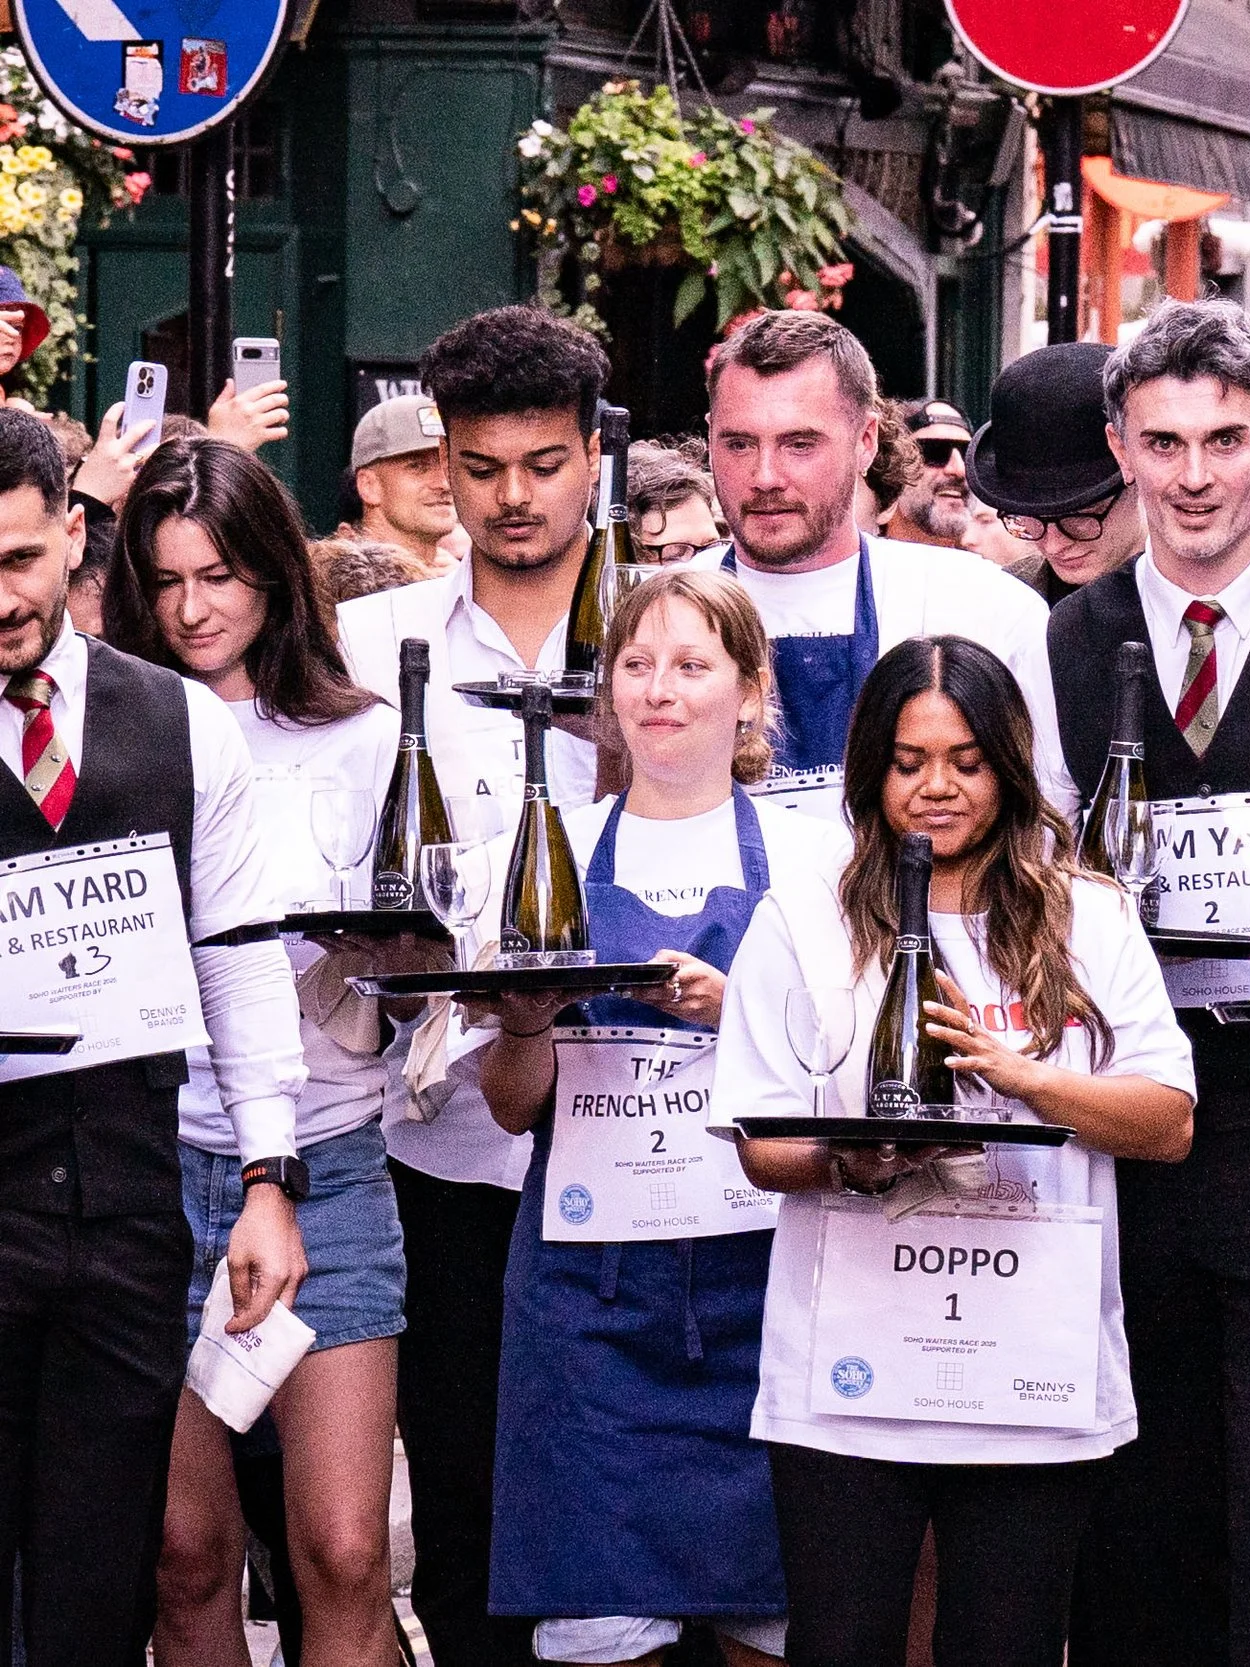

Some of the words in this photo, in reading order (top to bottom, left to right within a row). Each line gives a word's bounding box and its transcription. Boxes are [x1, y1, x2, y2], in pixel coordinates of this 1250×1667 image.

[54, 868, 147, 910] YARD
[1204, 901, 1220, 923] 2
[8, 937, 25, 955] &
[31, 912, 155, 951] RESTAURANT
[85, 946, 111, 975] 3
[28, 991, 49, 1000] SOHO
[83, 980, 102, 989] RACE
[49, 992, 92, 1004] SUPPORTED
[93, 988, 102, 996] BY
[1182, 986, 1211, 997] SOHO
[1216, 985, 1249, 996] HOUSE
[139, 1004, 186, 1021] DENNYS
[147, 1016, 184, 1029] BRANDS
[88, 1037, 122, 1051] HOUSE
[874, 1094, 913, 1102] LUNA
[572, 1093, 657, 1118] FRENCH
[650, 1130, 666, 1154] 2
[635, 1160, 666, 1168] WAITERS
[667, 1157, 687, 1165] RACE
[688, 1156, 703, 1164] 2025
[632, 1167, 674, 1176] SUPPORTED
[731, 1197, 773, 1209] BRANDS
[632, 1219, 661, 1229] SOHO
[663, 1215, 700, 1227] HOUSE
[893, 1244, 1019, 1278] DOPPO
[944, 1292, 962, 1321] 1
[903, 1336, 923, 1344] SOHO
[925, 1337, 958, 1346] WAITERS
[959, 1339, 979, 1347] RACE
[980, 1340, 997, 1348] 2025
[921, 1345, 965, 1354] SUPPORTED
[966, 1347, 978, 1355] BY
[1013, 1378, 1076, 1393] DENNYS
[914, 1397, 946, 1409] SOHO
[947, 1398, 985, 1410] HOUSE
[1020, 1392, 1069, 1402] BRANDS
